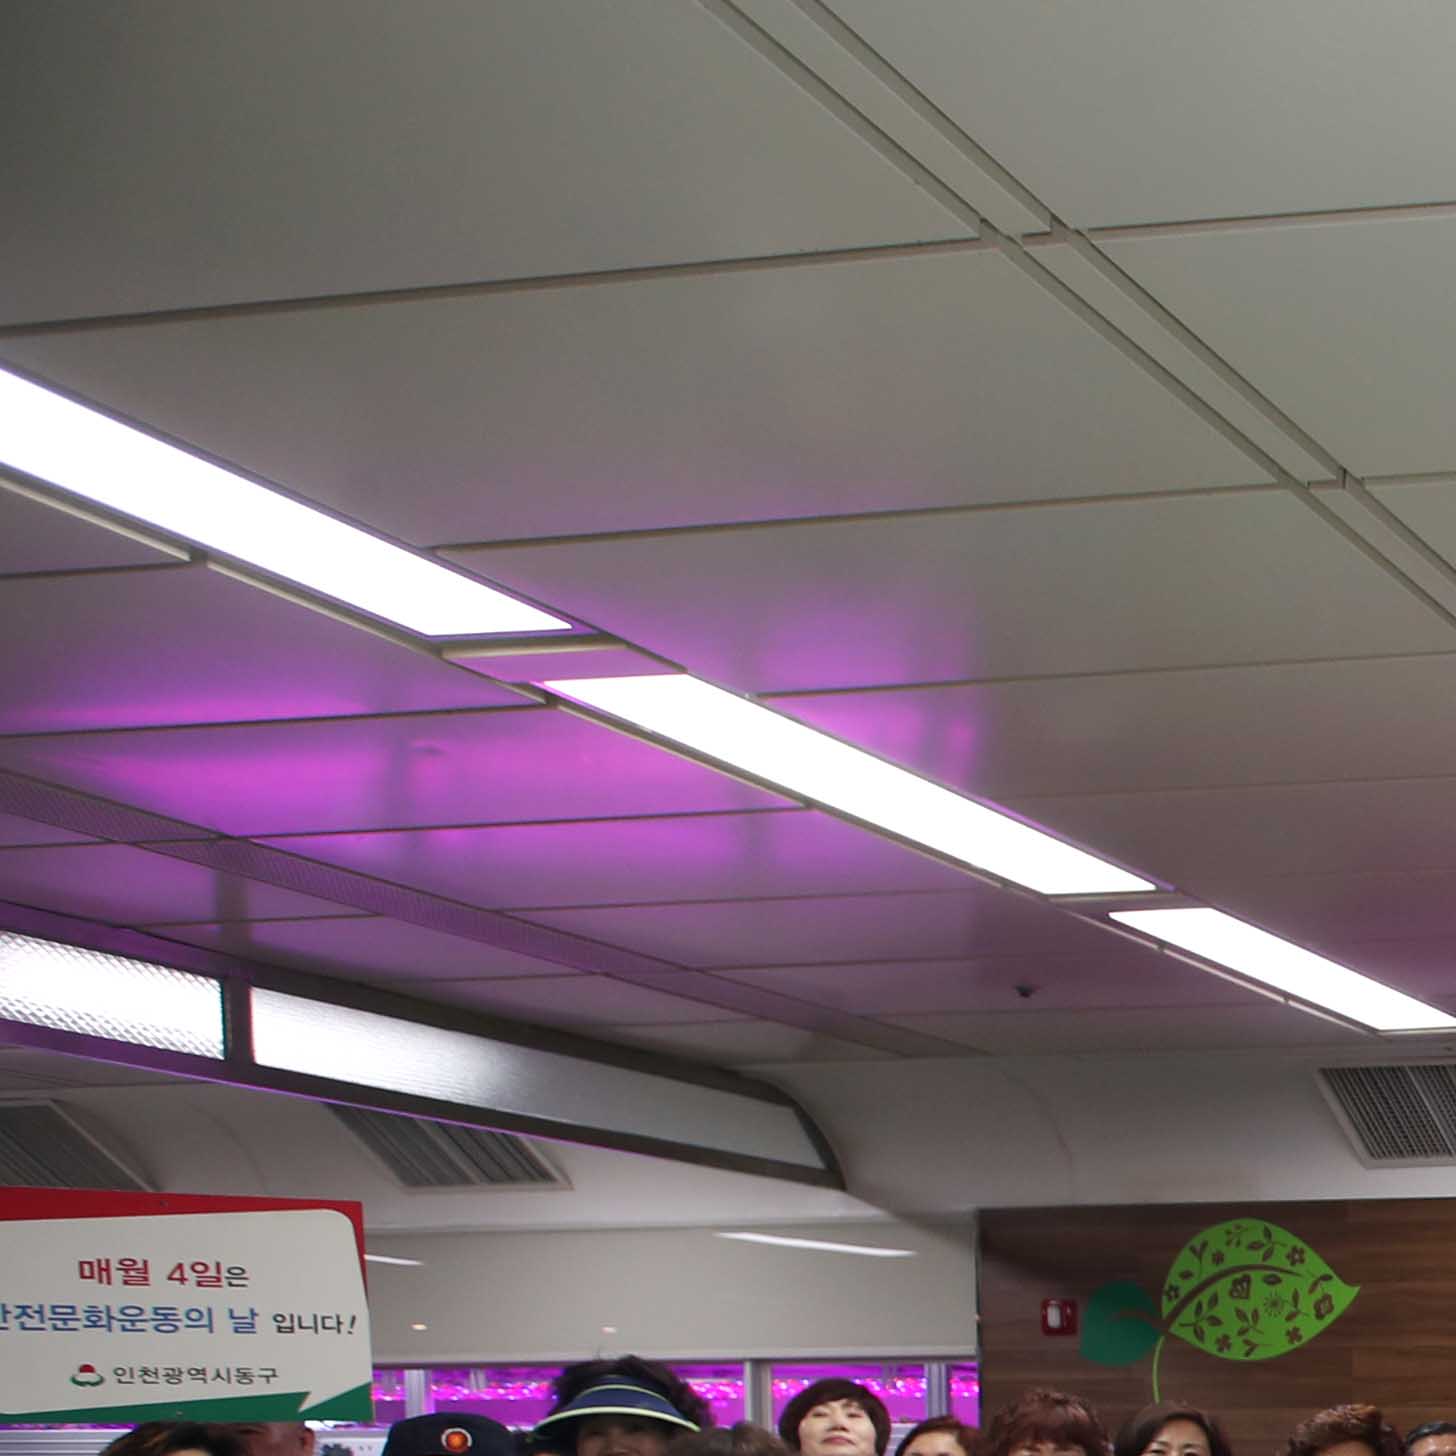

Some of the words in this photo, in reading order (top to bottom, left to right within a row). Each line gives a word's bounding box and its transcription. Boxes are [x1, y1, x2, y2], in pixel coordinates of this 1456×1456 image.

[78, 1258, 151, 1287] 매월
[167, 1261, 249, 1288] 4일은
[228, 1308, 259, 1334] 날
[272, 1313, 357, 1335] 입니다!
[113, 1366, 280, 1386] 인천광역시동구
